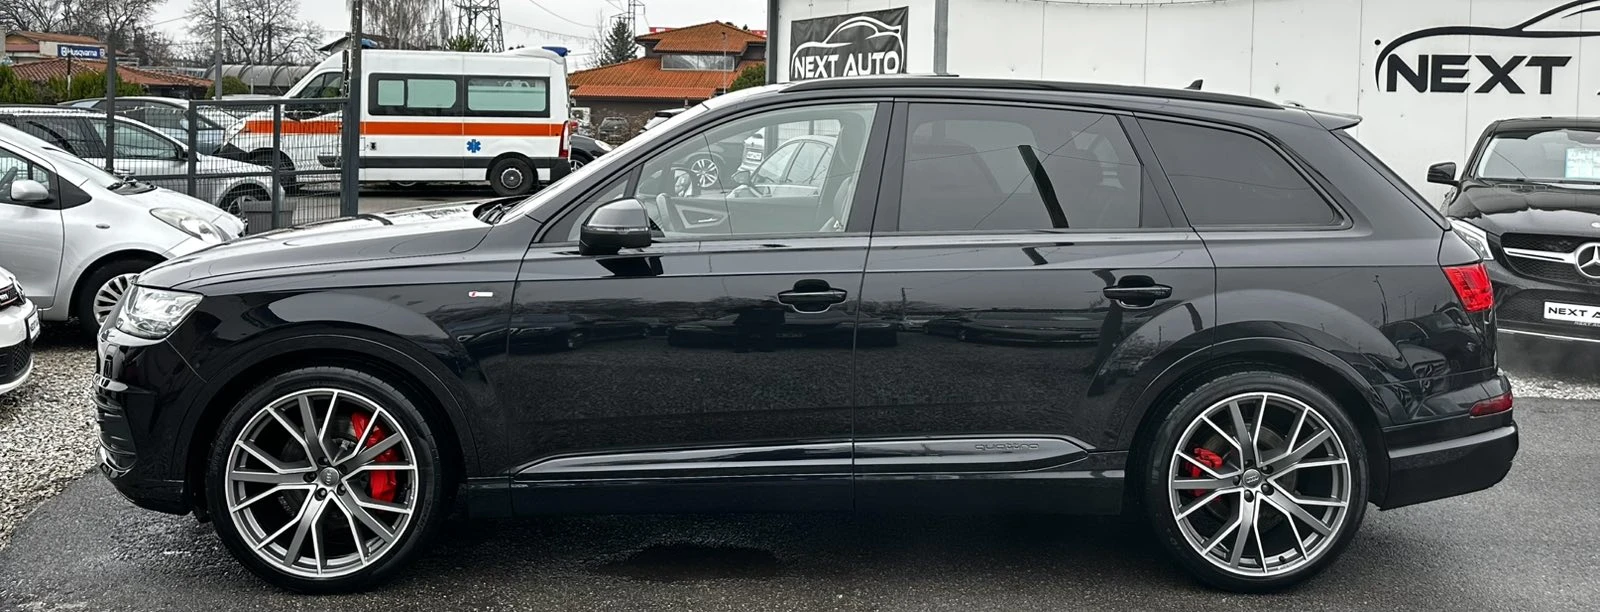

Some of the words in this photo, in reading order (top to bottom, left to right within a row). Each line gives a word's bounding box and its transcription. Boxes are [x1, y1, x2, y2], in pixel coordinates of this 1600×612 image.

[68, 48, 97, 57] Husqvarna
[794, 54, 839, 79] NEXT
[843, 50, 900, 77] AUTO
[1386, 53, 1573, 95] NEXT
[1548, 307, 1587, 316] NEXT
[974, 443, 1040, 451] quattro
